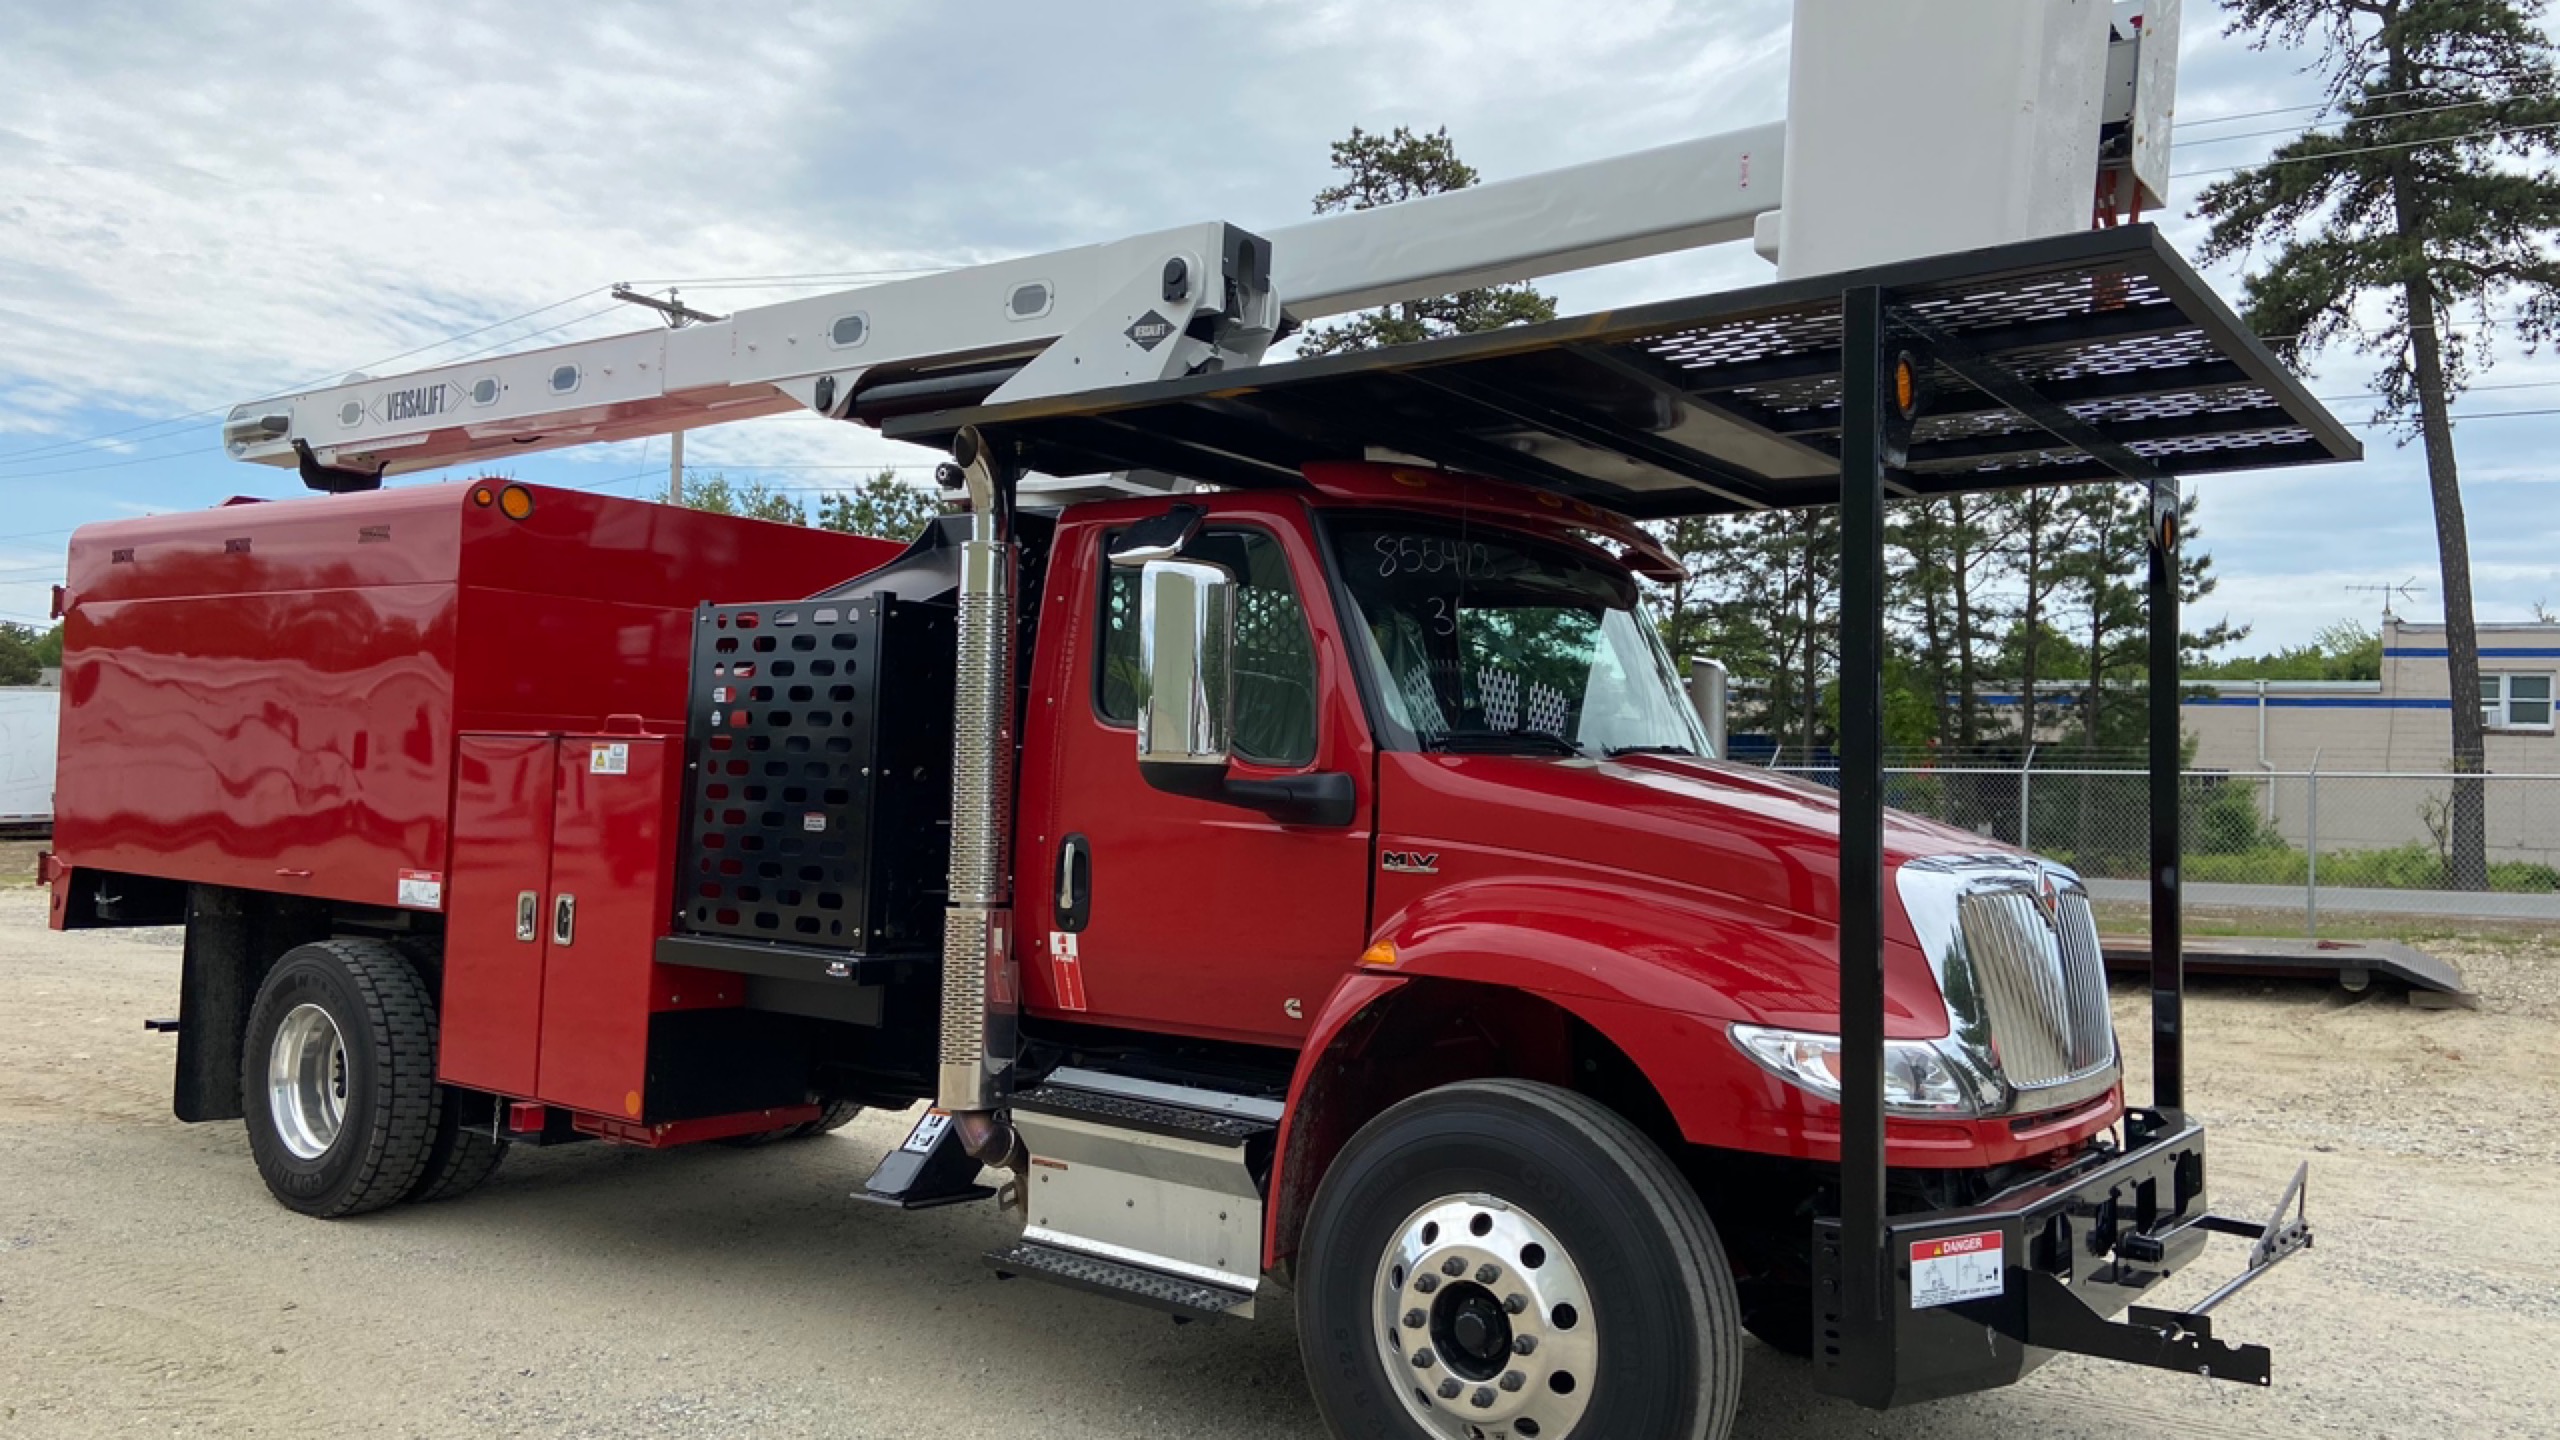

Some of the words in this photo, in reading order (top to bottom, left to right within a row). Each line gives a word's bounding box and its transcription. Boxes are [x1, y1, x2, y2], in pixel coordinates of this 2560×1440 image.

[387, 383, 447, 422] VERSALIFT
[1382, 850, 1439, 871] MV
[1943, 1237, 1983, 1255] DANGER
